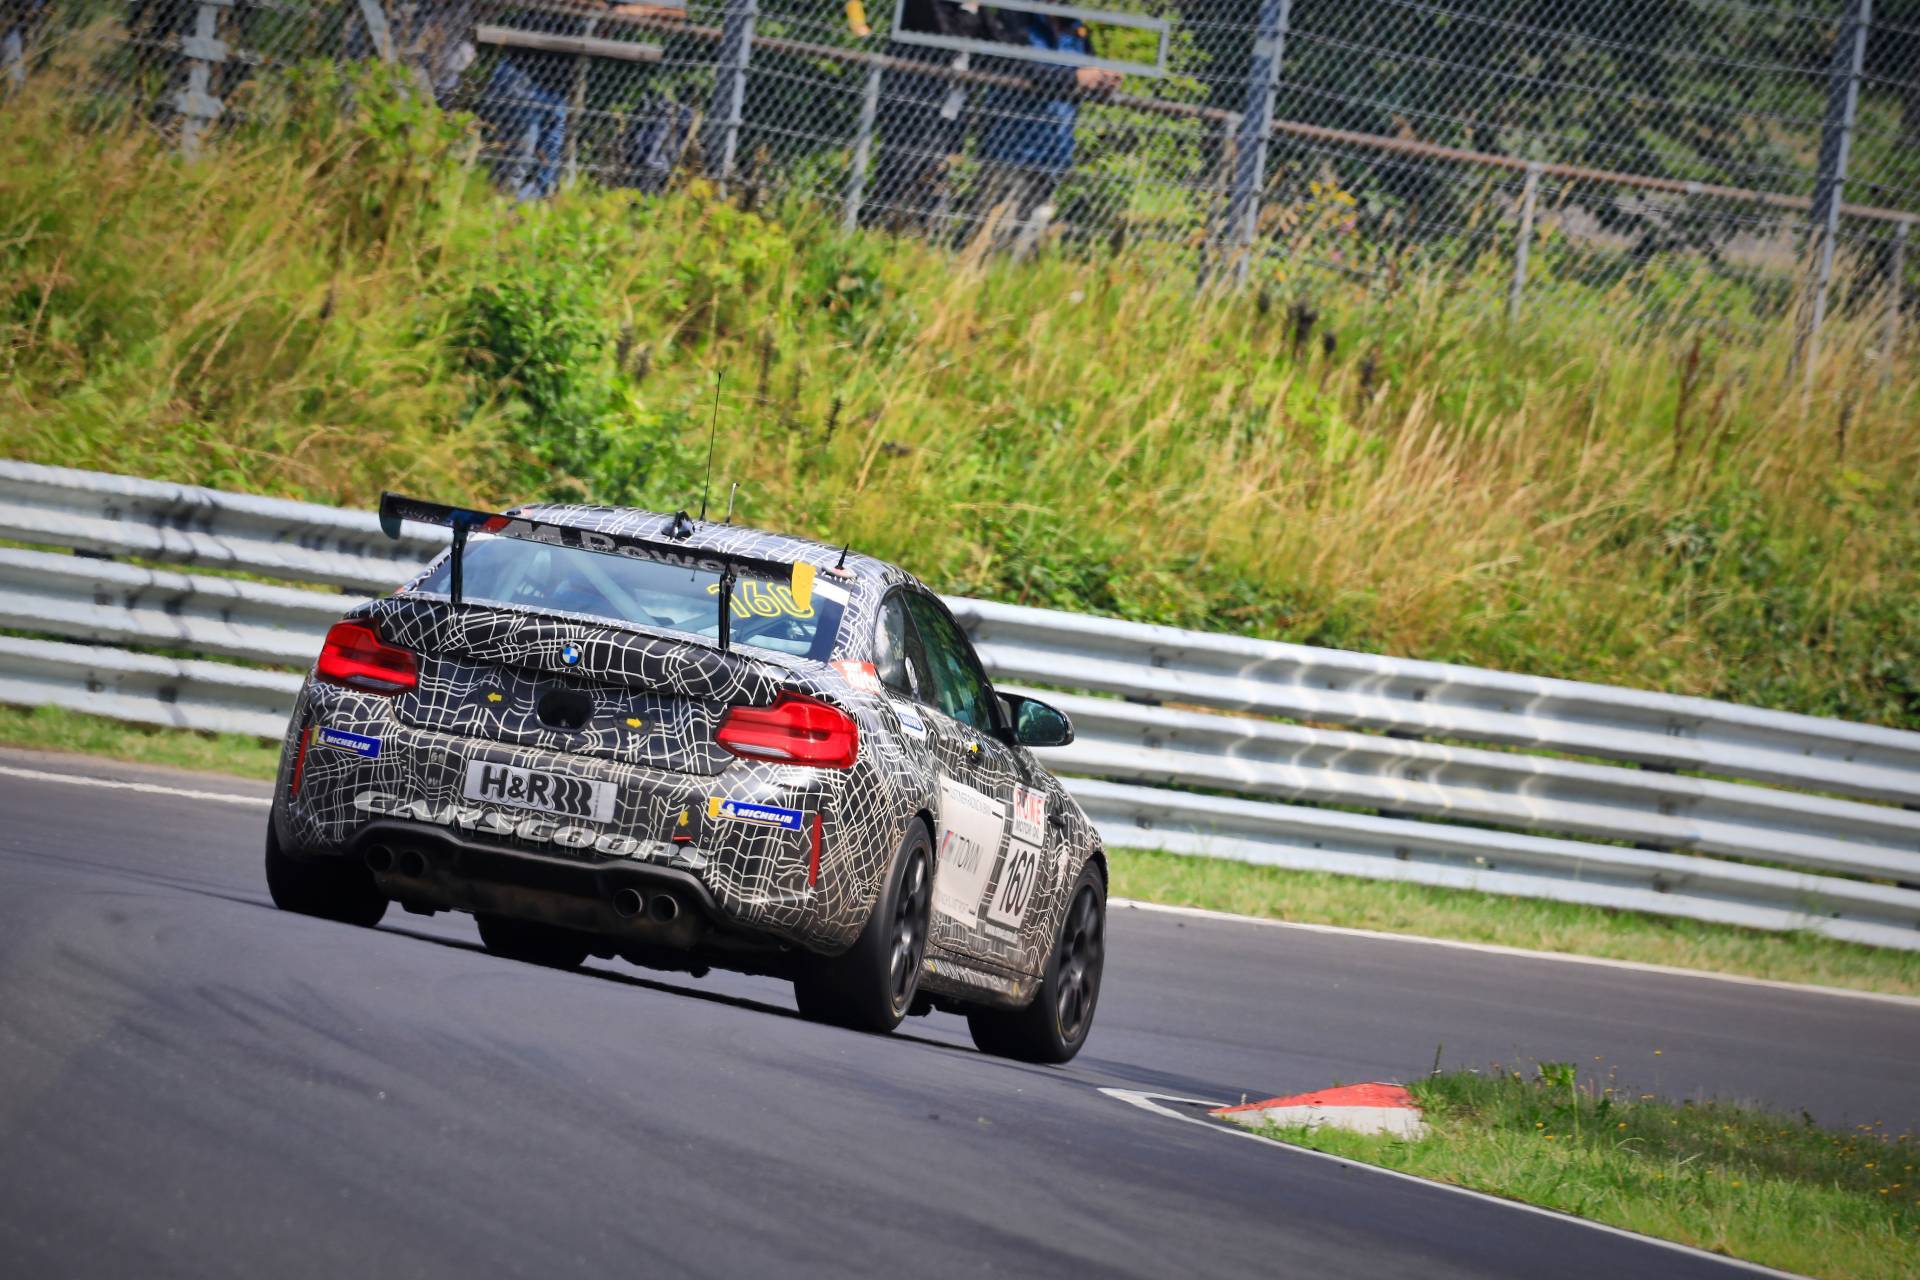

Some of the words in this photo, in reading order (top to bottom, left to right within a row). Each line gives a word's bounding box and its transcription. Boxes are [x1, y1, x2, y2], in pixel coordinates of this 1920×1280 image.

[707, 580, 814, 618] 160
[326, 735, 371, 751] MICHELIN
[479, 764, 549, 806] H&R
[737, 808, 793, 824] MICHELIN
[999, 849, 1036, 917] 160
